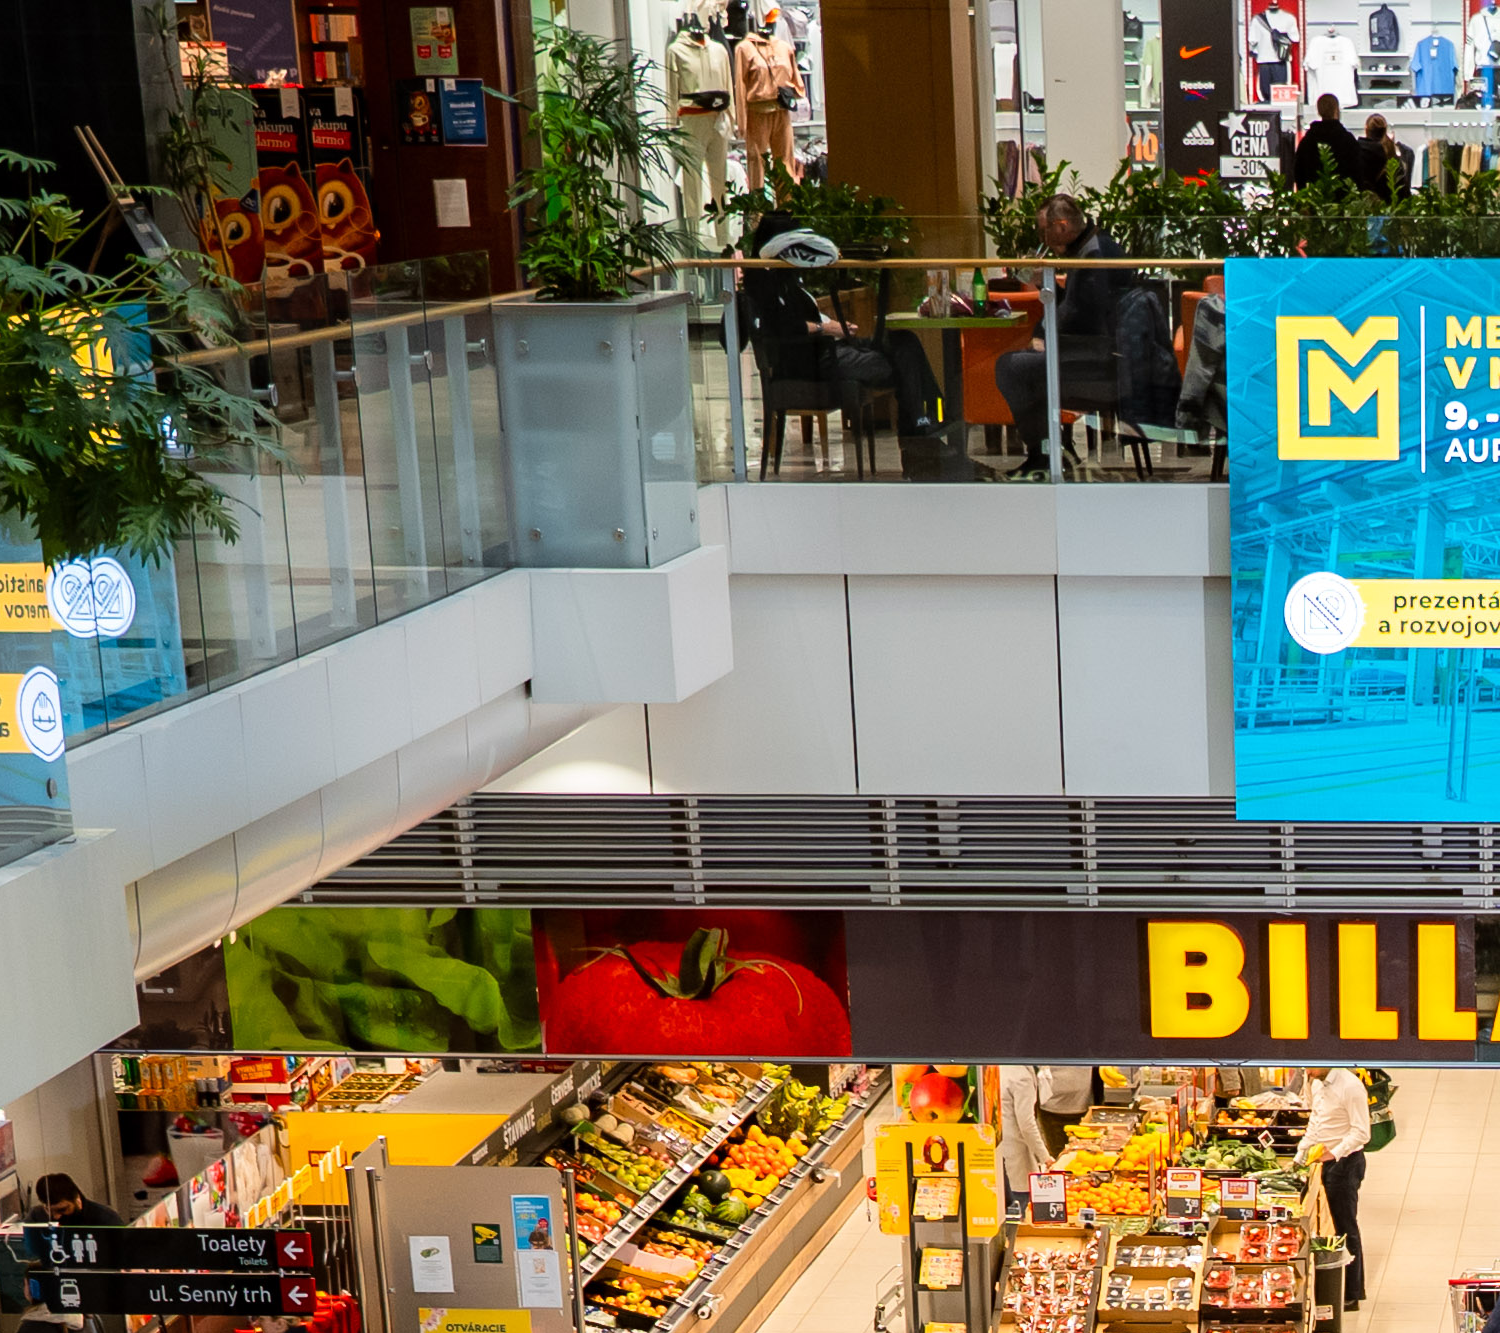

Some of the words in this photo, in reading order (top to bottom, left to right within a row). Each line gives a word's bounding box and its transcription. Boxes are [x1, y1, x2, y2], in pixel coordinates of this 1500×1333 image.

[1179, 82, 1215, 91] Reebok
[1248, 119, 1270, 135] TOP
[1182, 136, 1215, 146] adidas
[1231, 136, 1270, 157] CENA
[1447, 357, 1482, 390] V
[1444, 402, 1479, 432] 9.
[1378, 620, 1389, 635] a
[197, 1235, 265, 1255] Toalety
[239, 1258, 268, 1266] Toilets
[150, 1289, 173, 1302] ul.
[179, 1285, 237, 1306] Senný
[244, 1287, 271, 1303] trh
[446, 1322, 506, 1333] OTVÁRACIE
